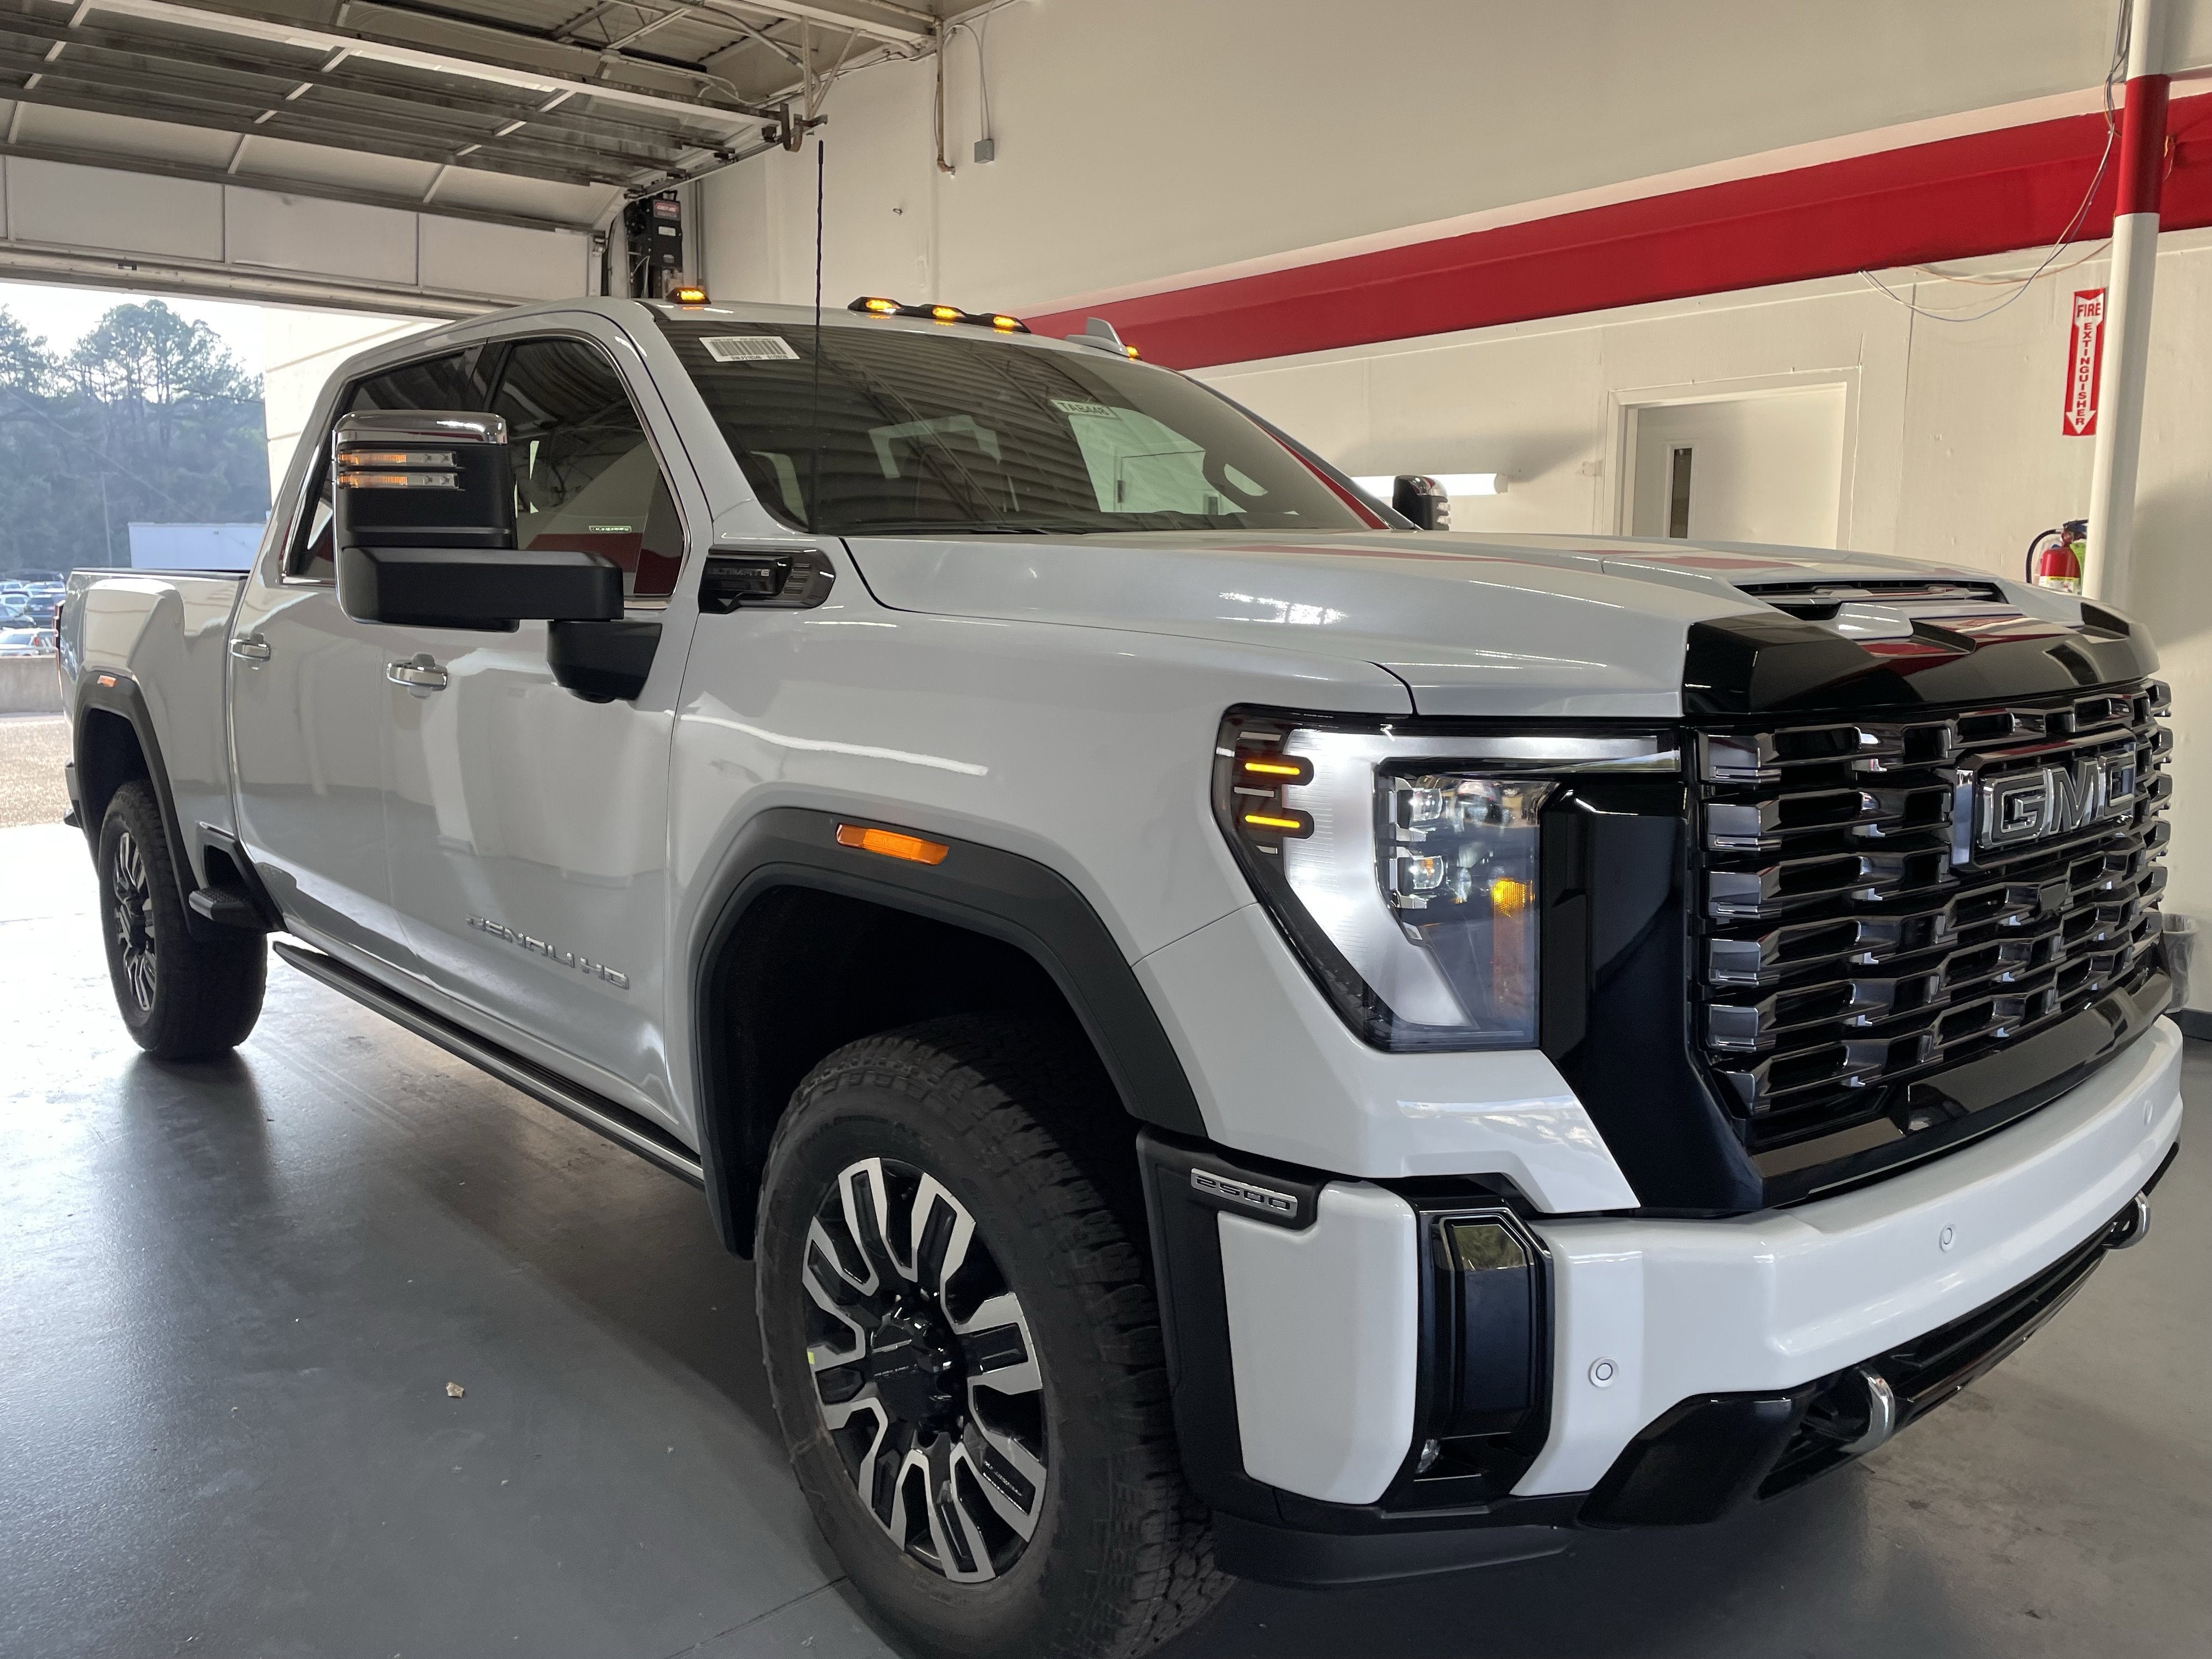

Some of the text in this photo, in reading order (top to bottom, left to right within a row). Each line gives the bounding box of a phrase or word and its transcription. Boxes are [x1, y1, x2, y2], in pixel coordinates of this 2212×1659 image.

[2076, 302, 2101, 317] FIRE
[2075, 322, 2092, 425] EXTINGUISHER
[1982, 750, 2136, 848] GMC
[466, 913, 629, 990] DENALI HD
[1196, 1176, 1290, 1210] 2500
